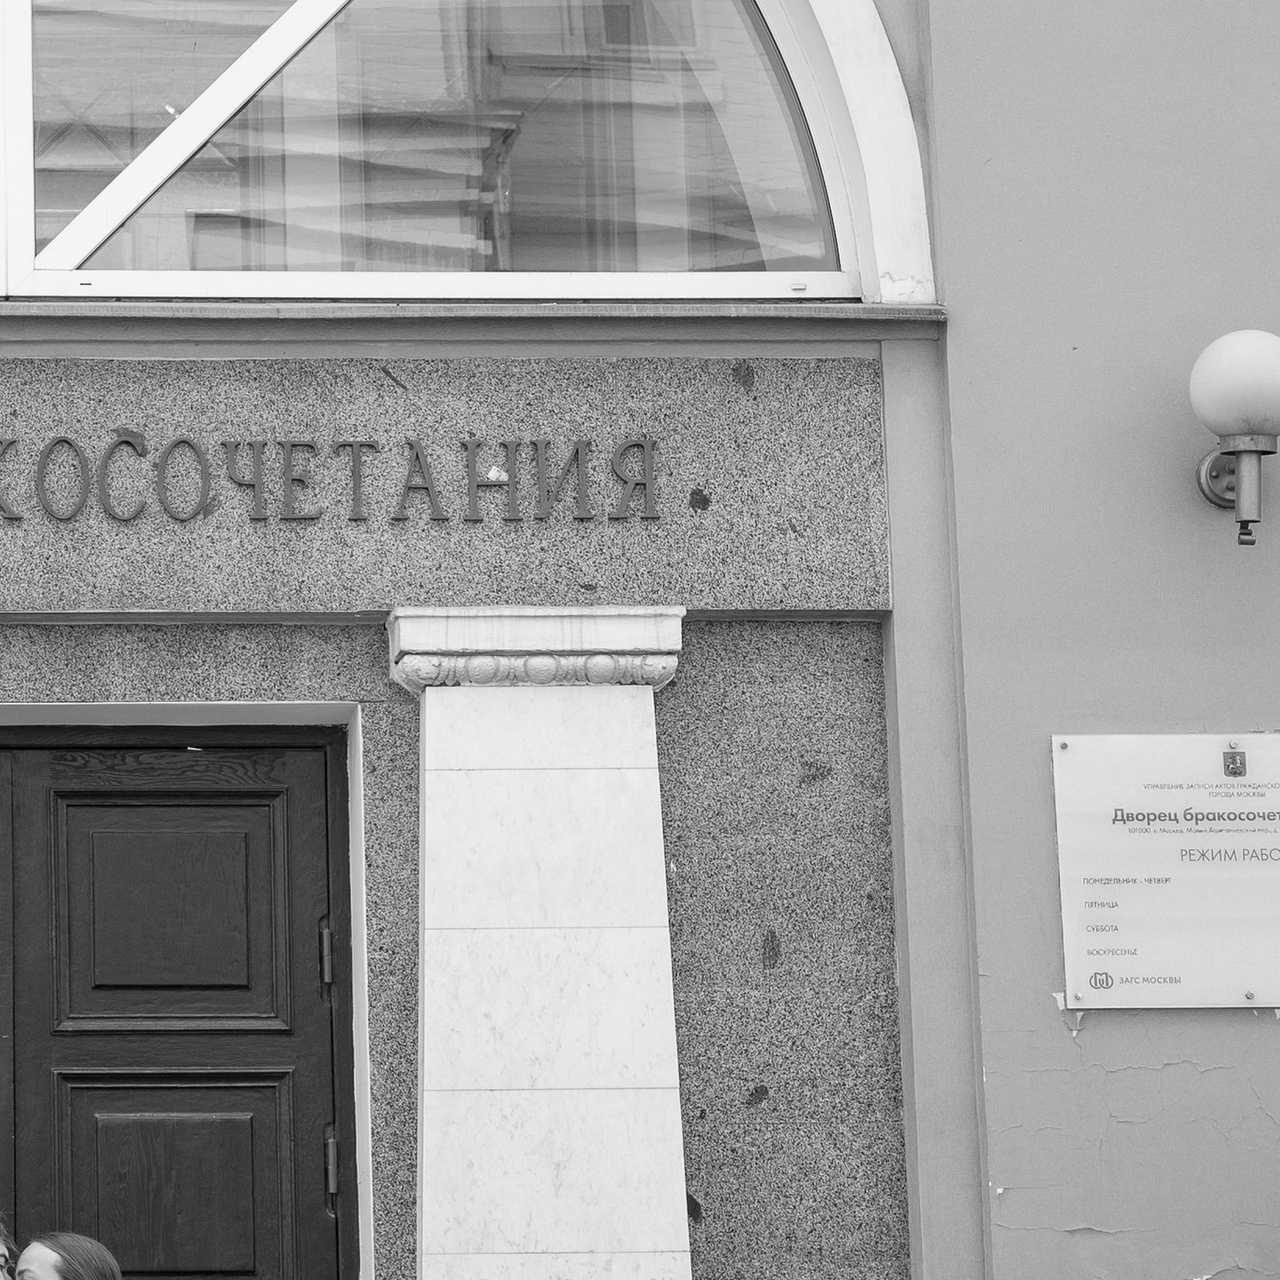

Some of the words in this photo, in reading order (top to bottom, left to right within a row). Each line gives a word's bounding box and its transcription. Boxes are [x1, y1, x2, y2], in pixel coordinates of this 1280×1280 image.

[1112, 807, 1179, 826] Дворец
[1180, 848, 1237, 862] РЕЖИМ
[1242, 847, 1280, 862] РАБО
[1082, 877, 1138, 885] ПОНЕДЕЛЬНИК
[1144, 877, 1172, 885] ЧЕТВЕРГ
[1085, 924, 1119, 932] СУББОТА
[1086, 948, 1138, 956] ВОСКРЕСЕНЬЕ
[1119, 976, 1141, 984] ЗАГС
[1142, 976, 1182, 984] МОСКВЫ
